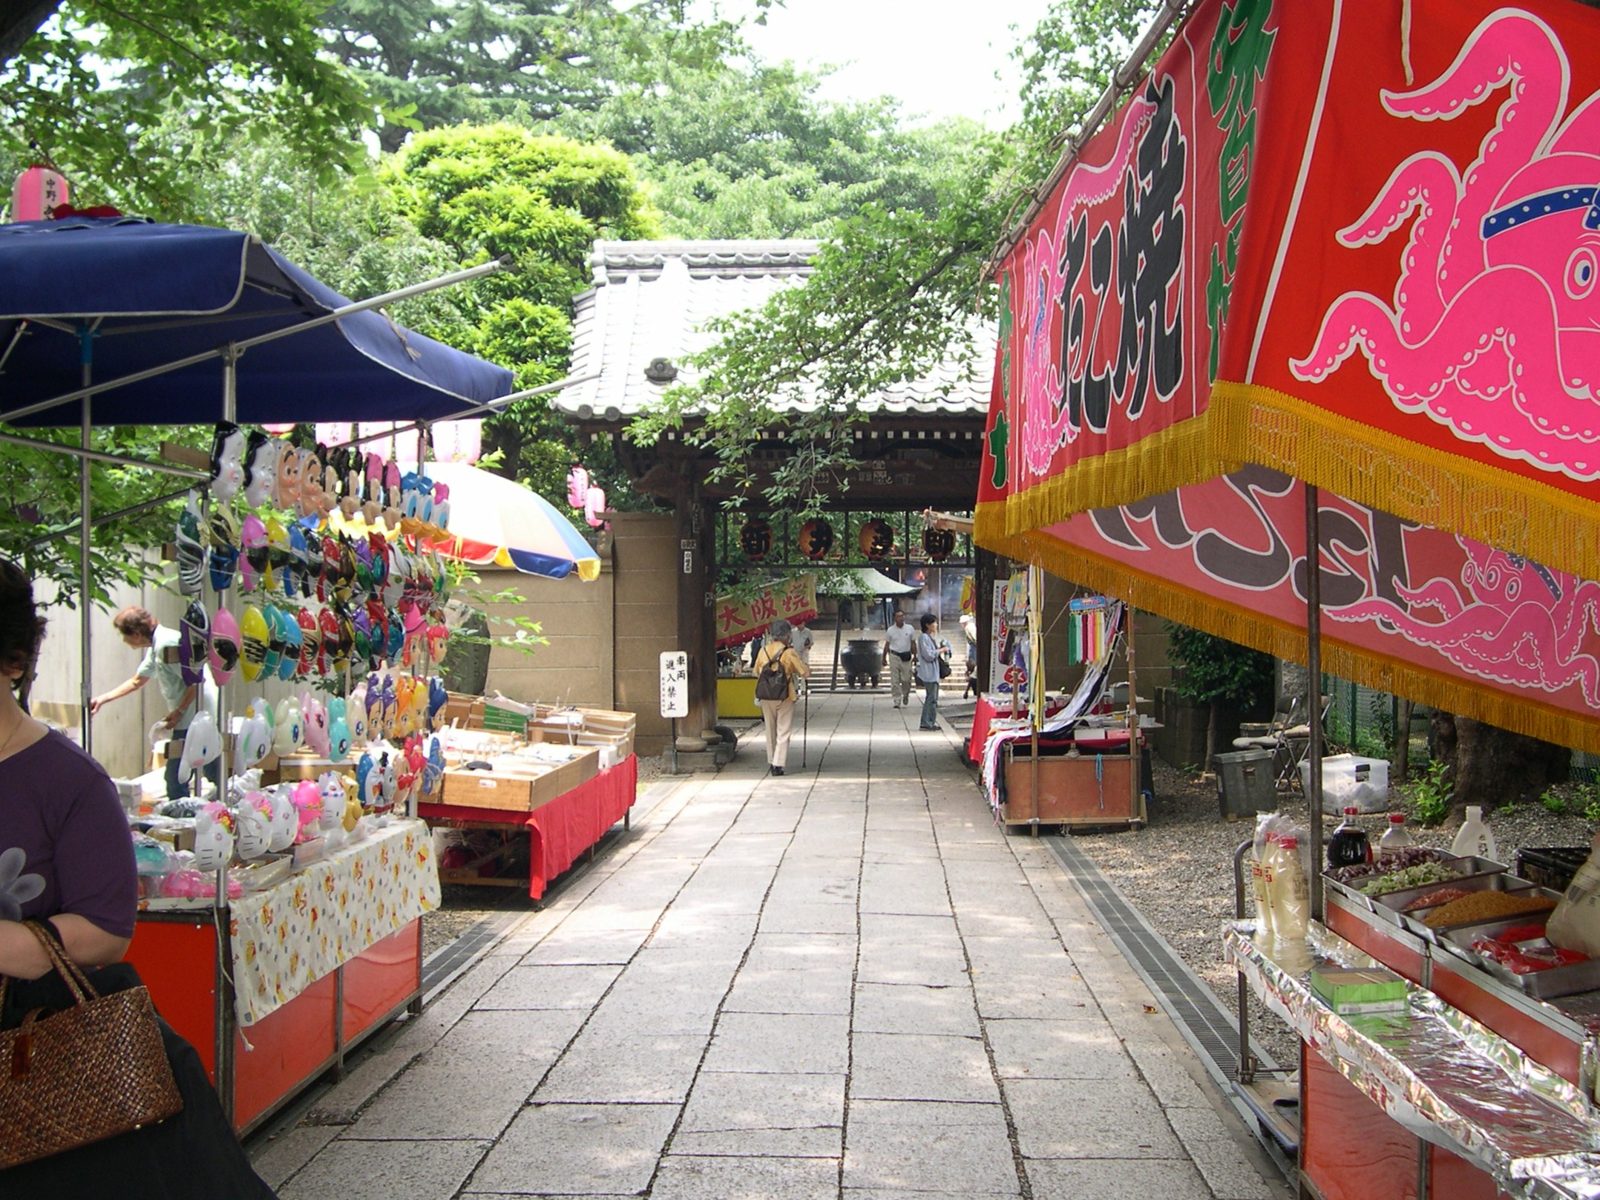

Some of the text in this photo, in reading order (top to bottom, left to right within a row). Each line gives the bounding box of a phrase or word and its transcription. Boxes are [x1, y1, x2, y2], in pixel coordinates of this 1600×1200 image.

[1059, 67, 1188, 440] たこ焼
[718, 581, 811, 633] 大阪焼
[666, 659, 676, 710] 進入禁止
[677, 655, 685, 680] 車両
